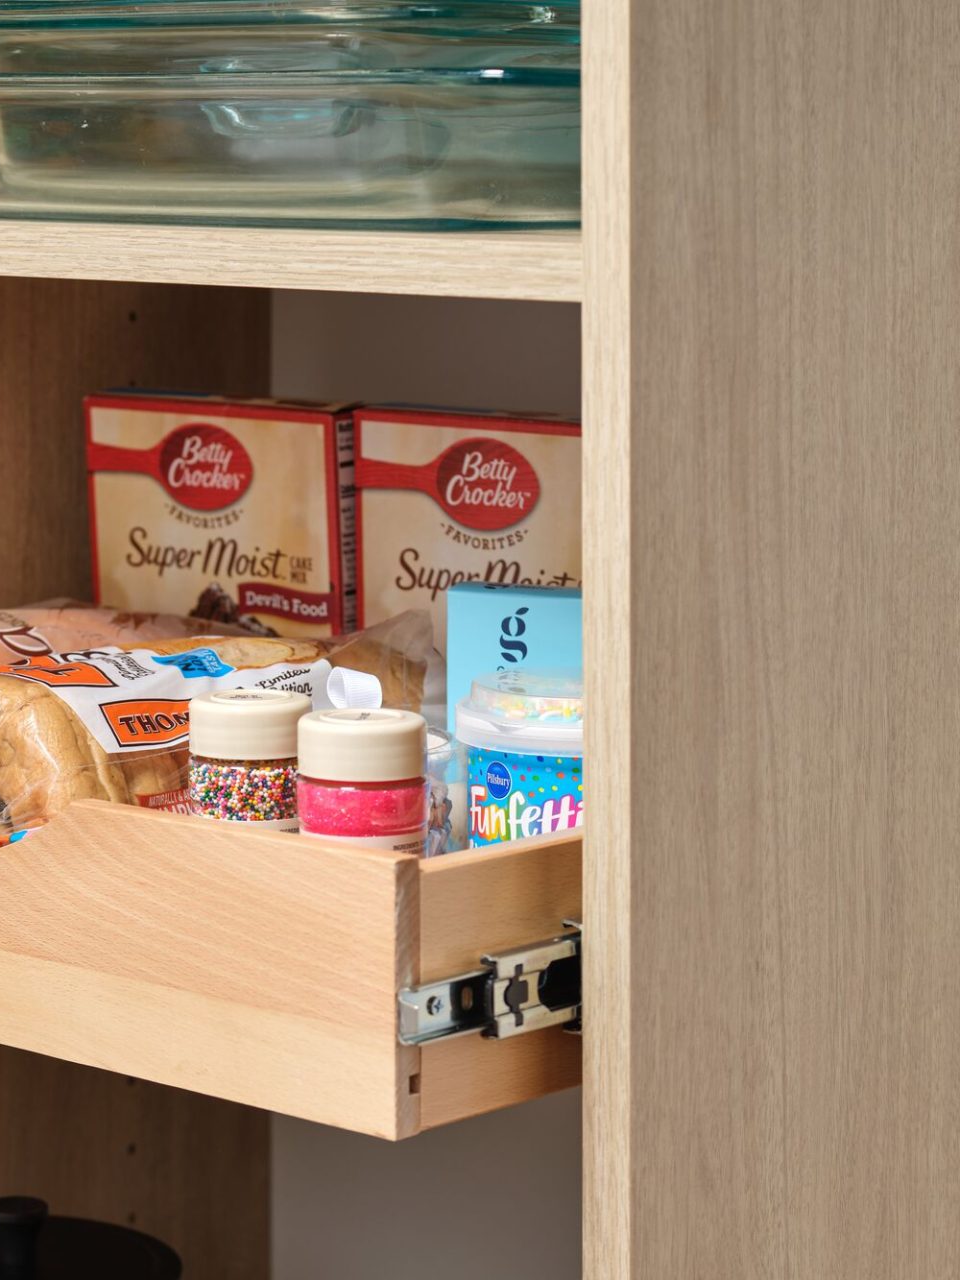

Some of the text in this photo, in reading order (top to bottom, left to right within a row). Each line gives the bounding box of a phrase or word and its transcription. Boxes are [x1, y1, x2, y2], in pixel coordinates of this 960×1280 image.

[182, 435, 234, 472] Betty
[167, 457, 240, 490] Crocker
[461, 451, 517, 491] Betty
[446, 474, 524, 509] Crocker
[290, 556, 313, 571] CAKE
[246, 591, 328, 617] Devil's Food
[487, 772, 511, 790] Pillsbury
